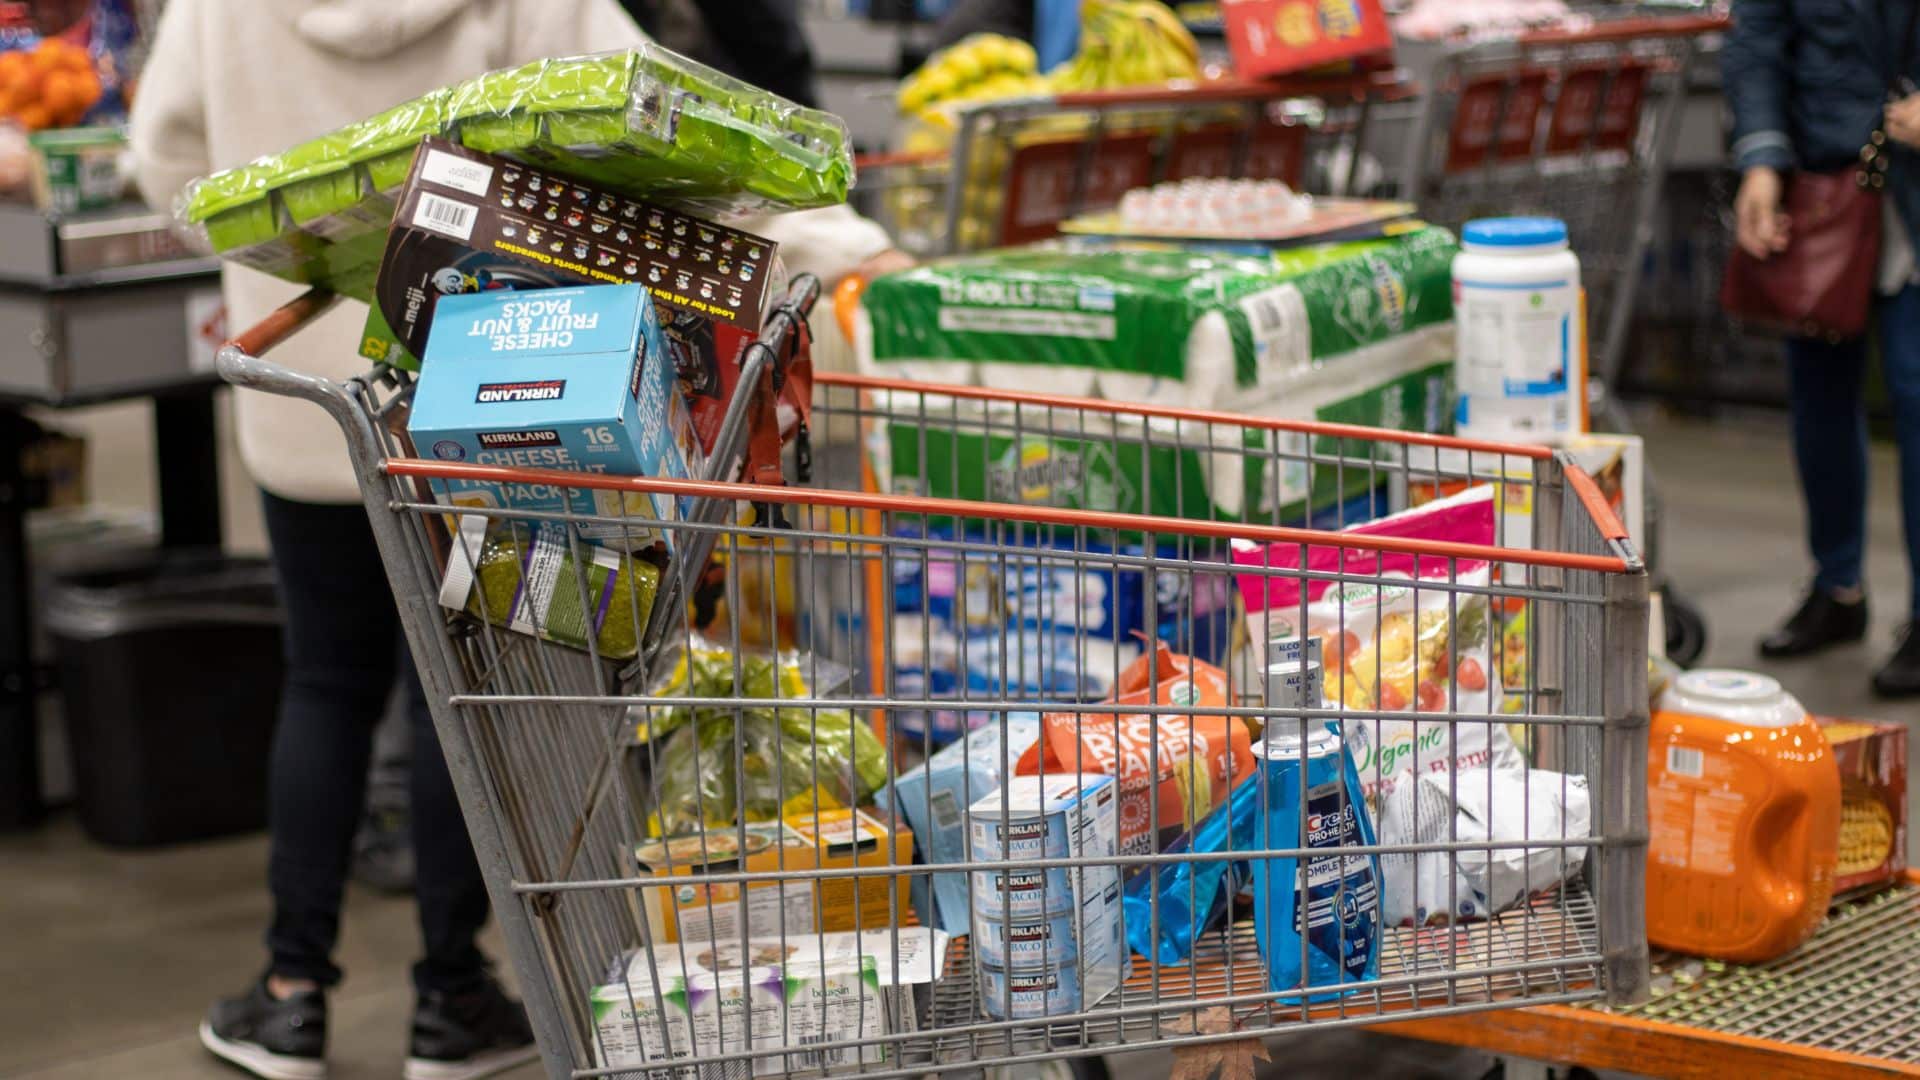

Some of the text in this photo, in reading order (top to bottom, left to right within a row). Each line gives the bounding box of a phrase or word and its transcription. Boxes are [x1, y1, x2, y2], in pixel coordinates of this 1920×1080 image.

[495, 240, 624, 285] Panda Sports Characters
[654, 287, 673, 301] the
[673, 295, 690, 305] All
[403, 285, 426, 323] meiji
[502, 298, 571, 317] PACKS
[691, 300, 708, 311] for
[708, 305, 736, 320] Look
[467, 311, 599, 336] FRUIT & NUT
[363, 336, 388, 360] 32
[488, 330, 573, 351] CHEESE,
[479, 386, 561, 402] KIRKLAND
[481, 431, 556, 443] KIRKLAND
[582, 426, 615, 444] 16
[1082, 714, 1192, 760] RICE
[1430, 749, 1491, 773] Bend
[1308, 804, 1353, 833] Cret
[998, 823, 1048, 836] KRKLAND
[1308, 821, 1356, 843] PRO-HELTH
[1299, 856, 1348, 878] OMPLEE
[997, 875, 1045, 887] KRKLAN
[1002, 925, 1050, 937] RKLAND
[1009, 975, 1057, 987] KIRKLAD
